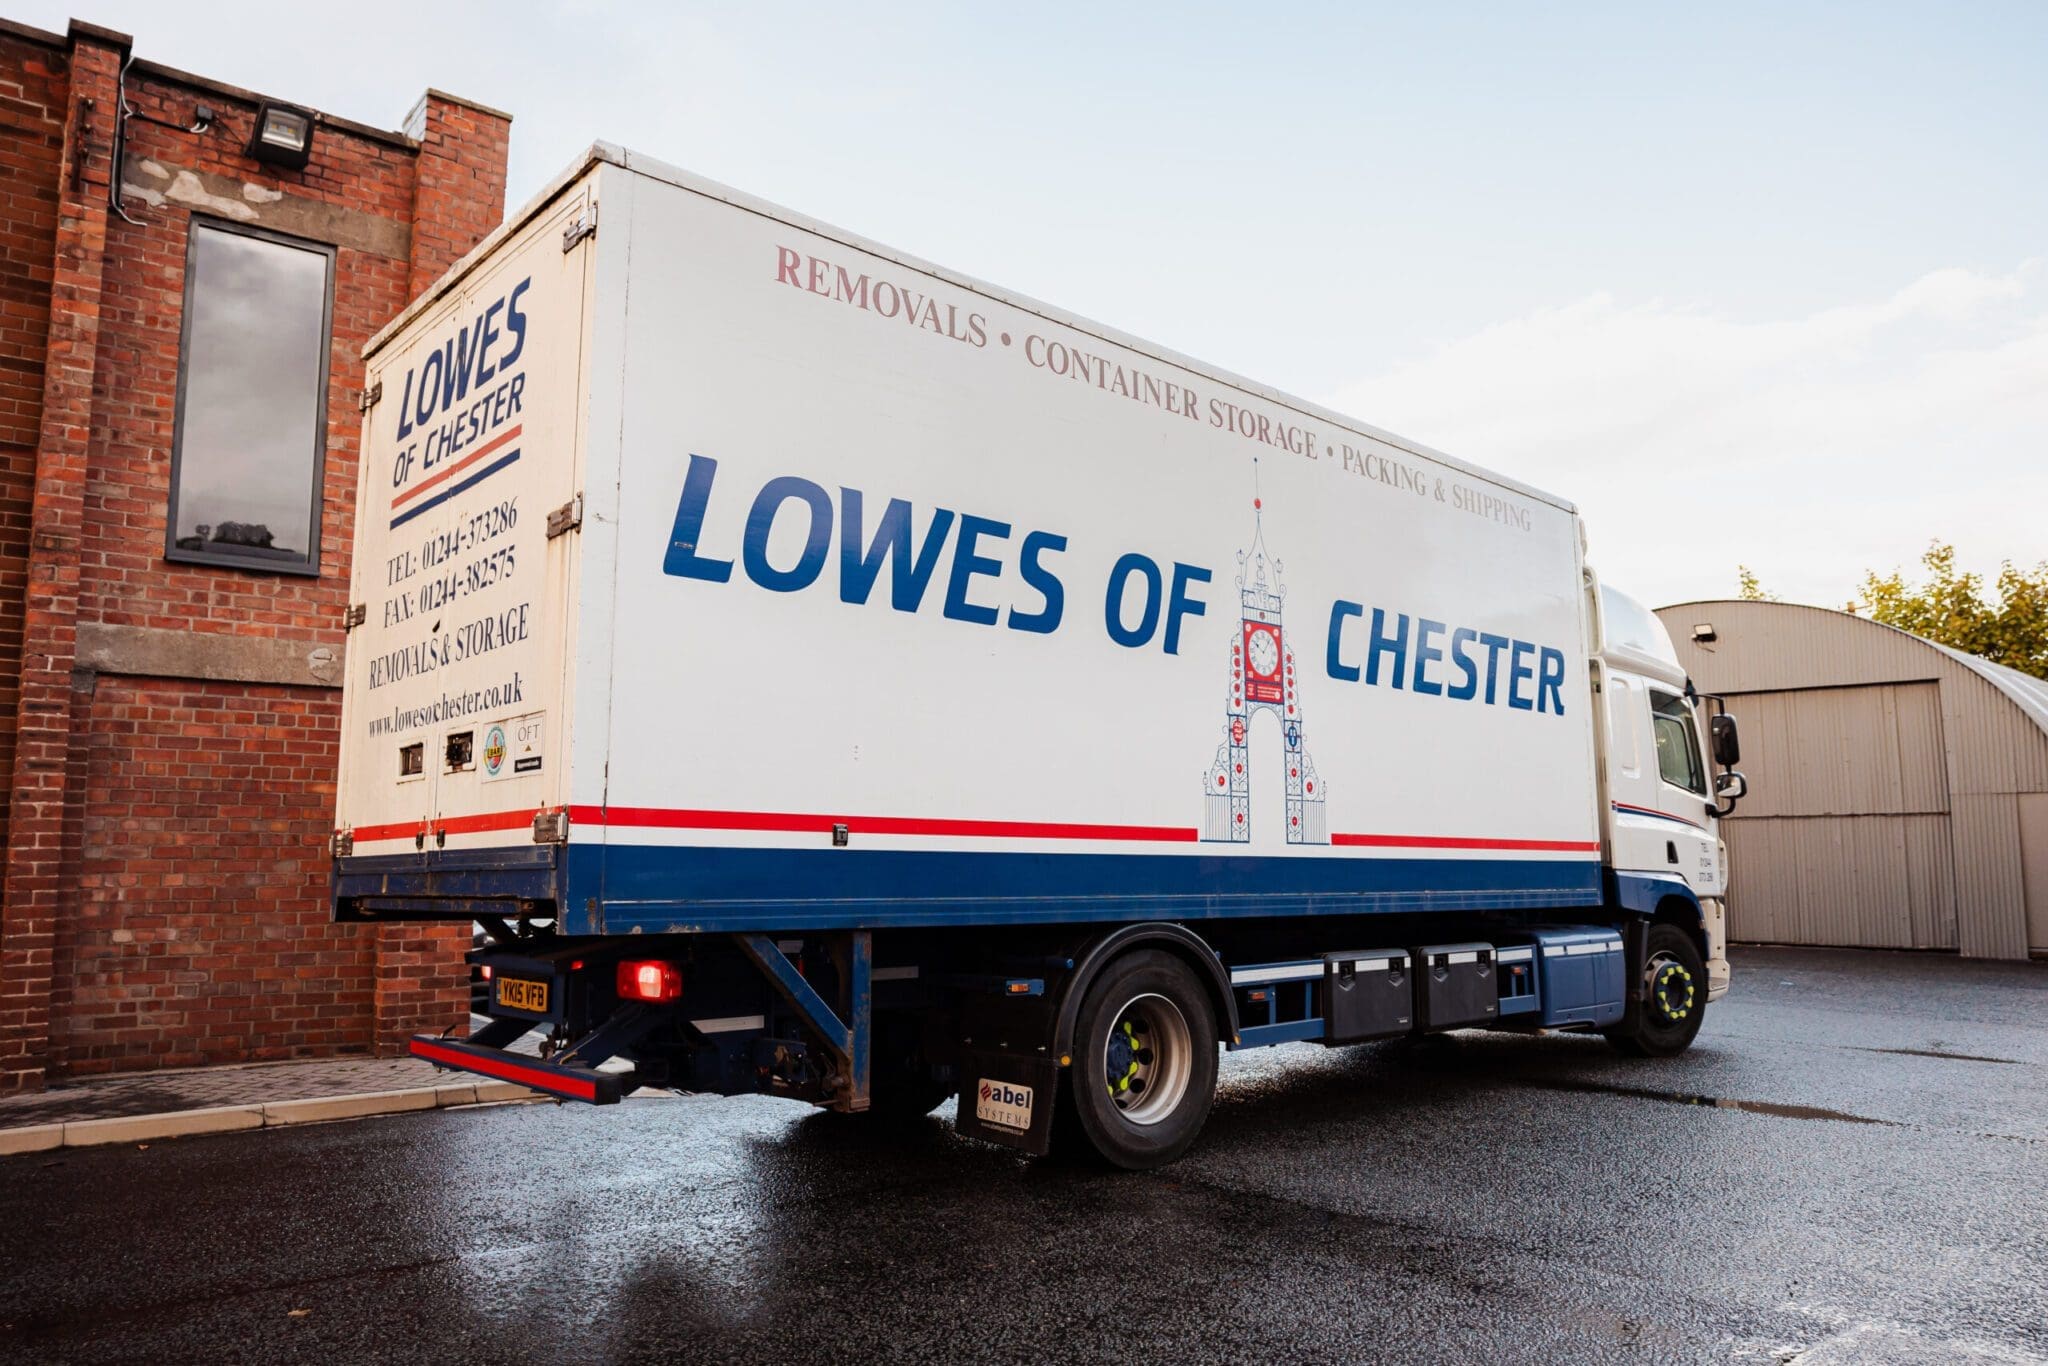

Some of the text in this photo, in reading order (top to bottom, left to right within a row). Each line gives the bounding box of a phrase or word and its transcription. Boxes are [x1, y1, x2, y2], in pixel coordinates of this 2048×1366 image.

[397, 275, 531, 443] LOWES
[775, 244, 1531, 533] REMOVALS CONTAINER STORAGE PACKING & SHIPPING
[393, 372, 526, 489] OF CHESTER
[388, 496, 518, 587] TEL: 01244-373286
[662, 453, 1565, 716] LOWES OF CHESTER
[384, 544, 516, 629] FAX: 01244-382575
[369, 602, 529, 690] REMOVALS & STORAGE
[517, 723, 540, 741] OFT
[503, 979, 544, 1007] YK15 VFB
[977, 1106, 1029, 1127] SYSTEMS
[991, 1085, 1030, 1109] abel
